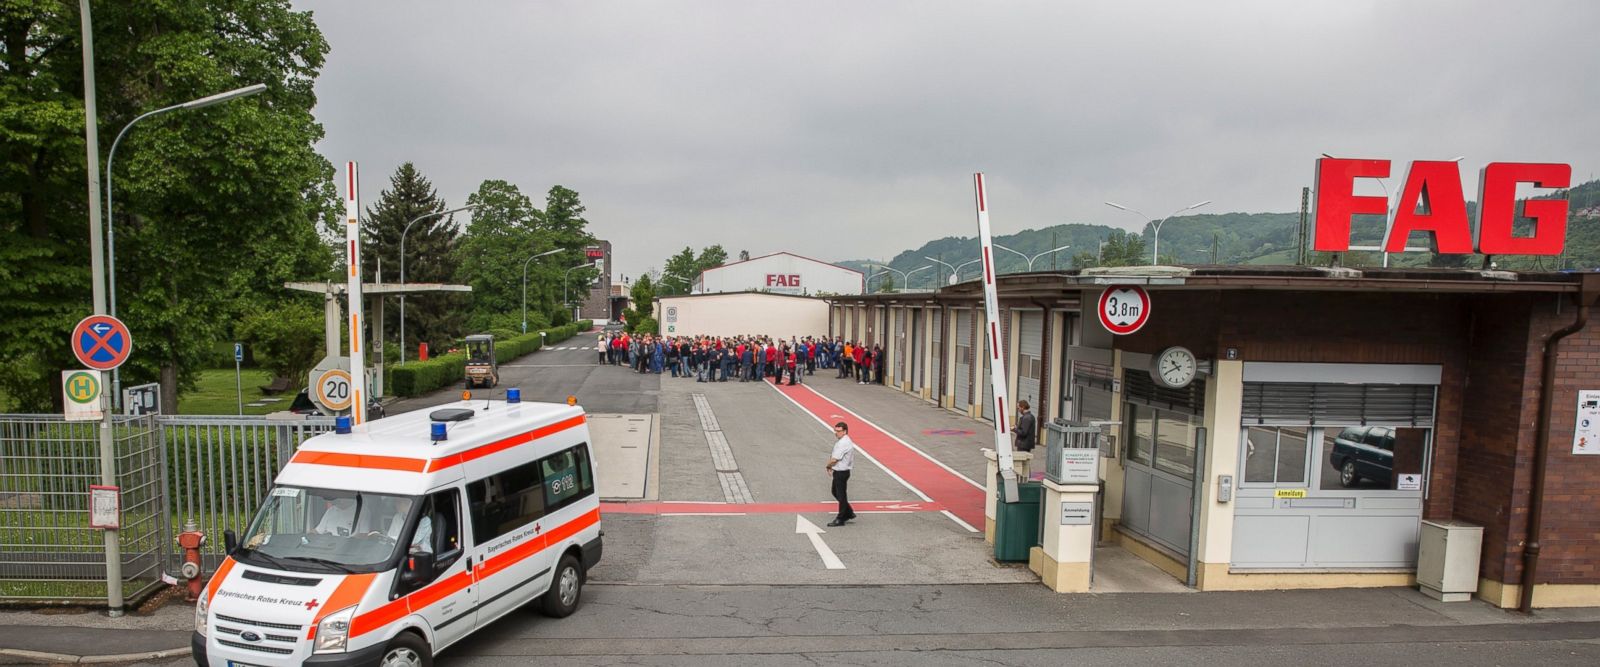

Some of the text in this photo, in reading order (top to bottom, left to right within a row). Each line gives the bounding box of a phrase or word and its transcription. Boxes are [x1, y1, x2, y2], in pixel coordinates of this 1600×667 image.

[1310, 158, 1571, 254] FAG
[767, 274, 800, 287] FAG
[74, 379, 91, 397] H
[326, 380, 349, 399] 20
[562, 474, 574, 491] 112
[1278, 490, 1304, 498] Anmeldung
[487, 540, 512, 553] Bayerisches
[217, 588, 303, 606] Bayerisches Rotes Kreuz
